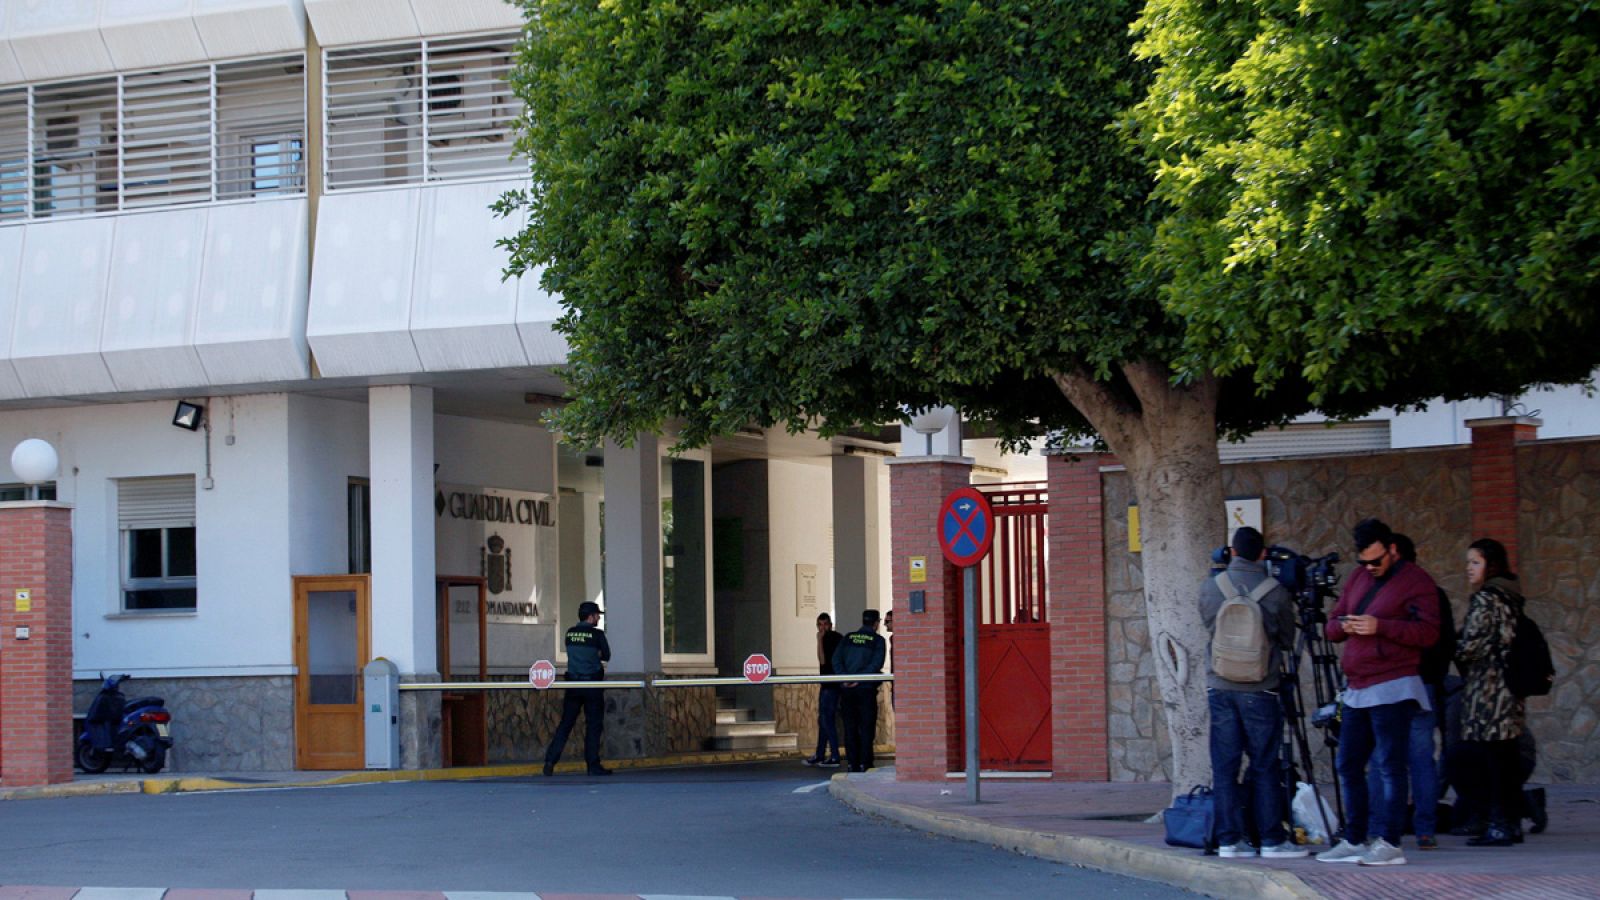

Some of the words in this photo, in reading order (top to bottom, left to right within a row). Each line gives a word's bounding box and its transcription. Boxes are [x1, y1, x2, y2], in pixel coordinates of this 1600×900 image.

[449, 492, 514, 523] GUARDIA
[516, 499, 555, 527] CIVIL
[531, 669, 553, 680] STOP
[746, 663, 769, 675] STOP
